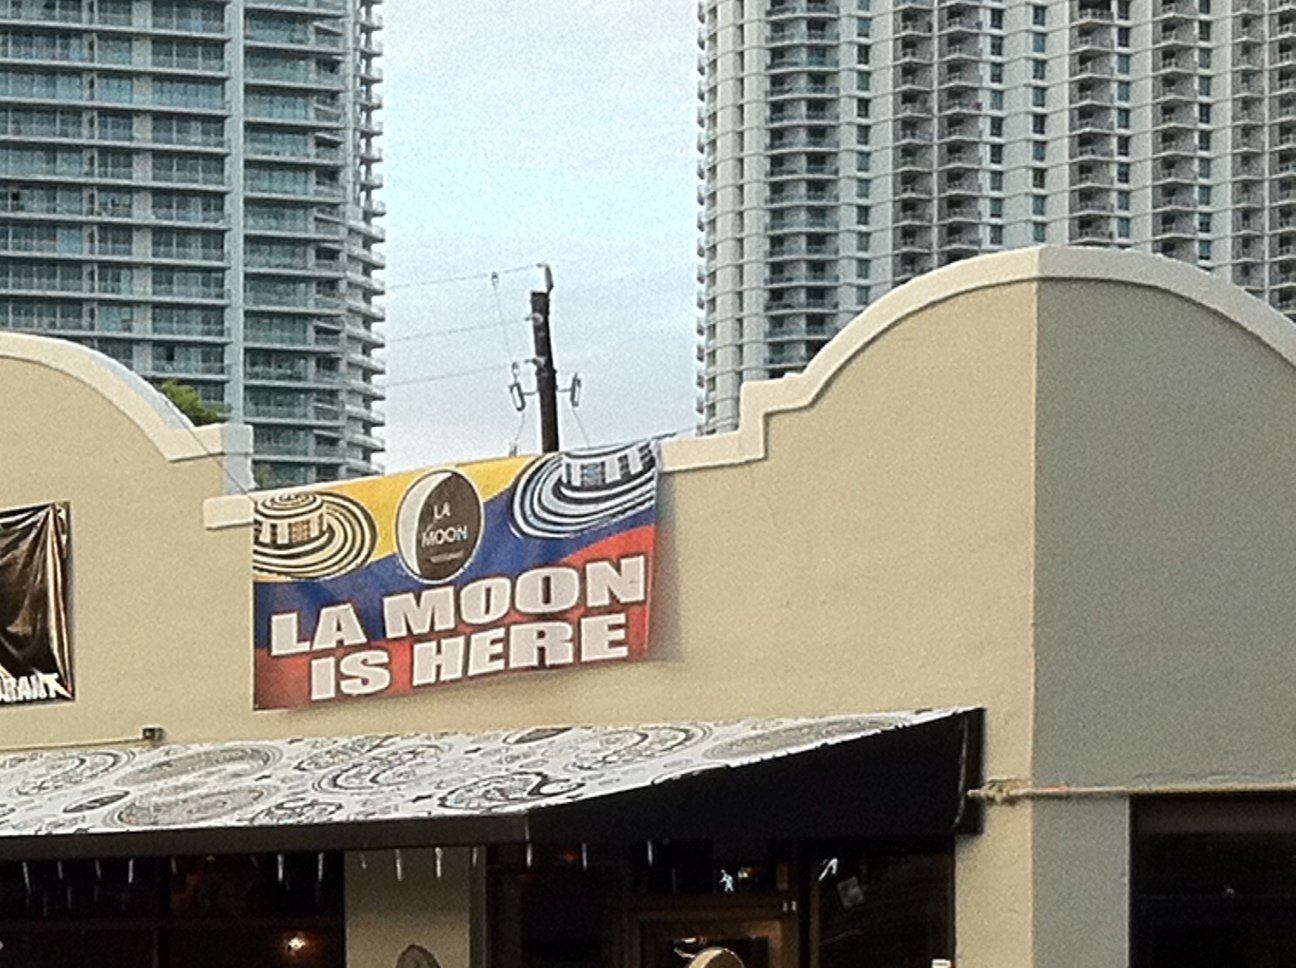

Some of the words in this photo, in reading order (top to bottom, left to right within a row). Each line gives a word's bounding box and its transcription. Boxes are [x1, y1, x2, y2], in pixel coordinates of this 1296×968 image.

[421, 525, 468, 548] MOON
[433, 502, 451, 520] LA
[270, 602, 368, 657] LA
[382, 555, 646, 640] MOON
[310, 648, 391, 701] IS
[411, 612, 629, 688] HERE
